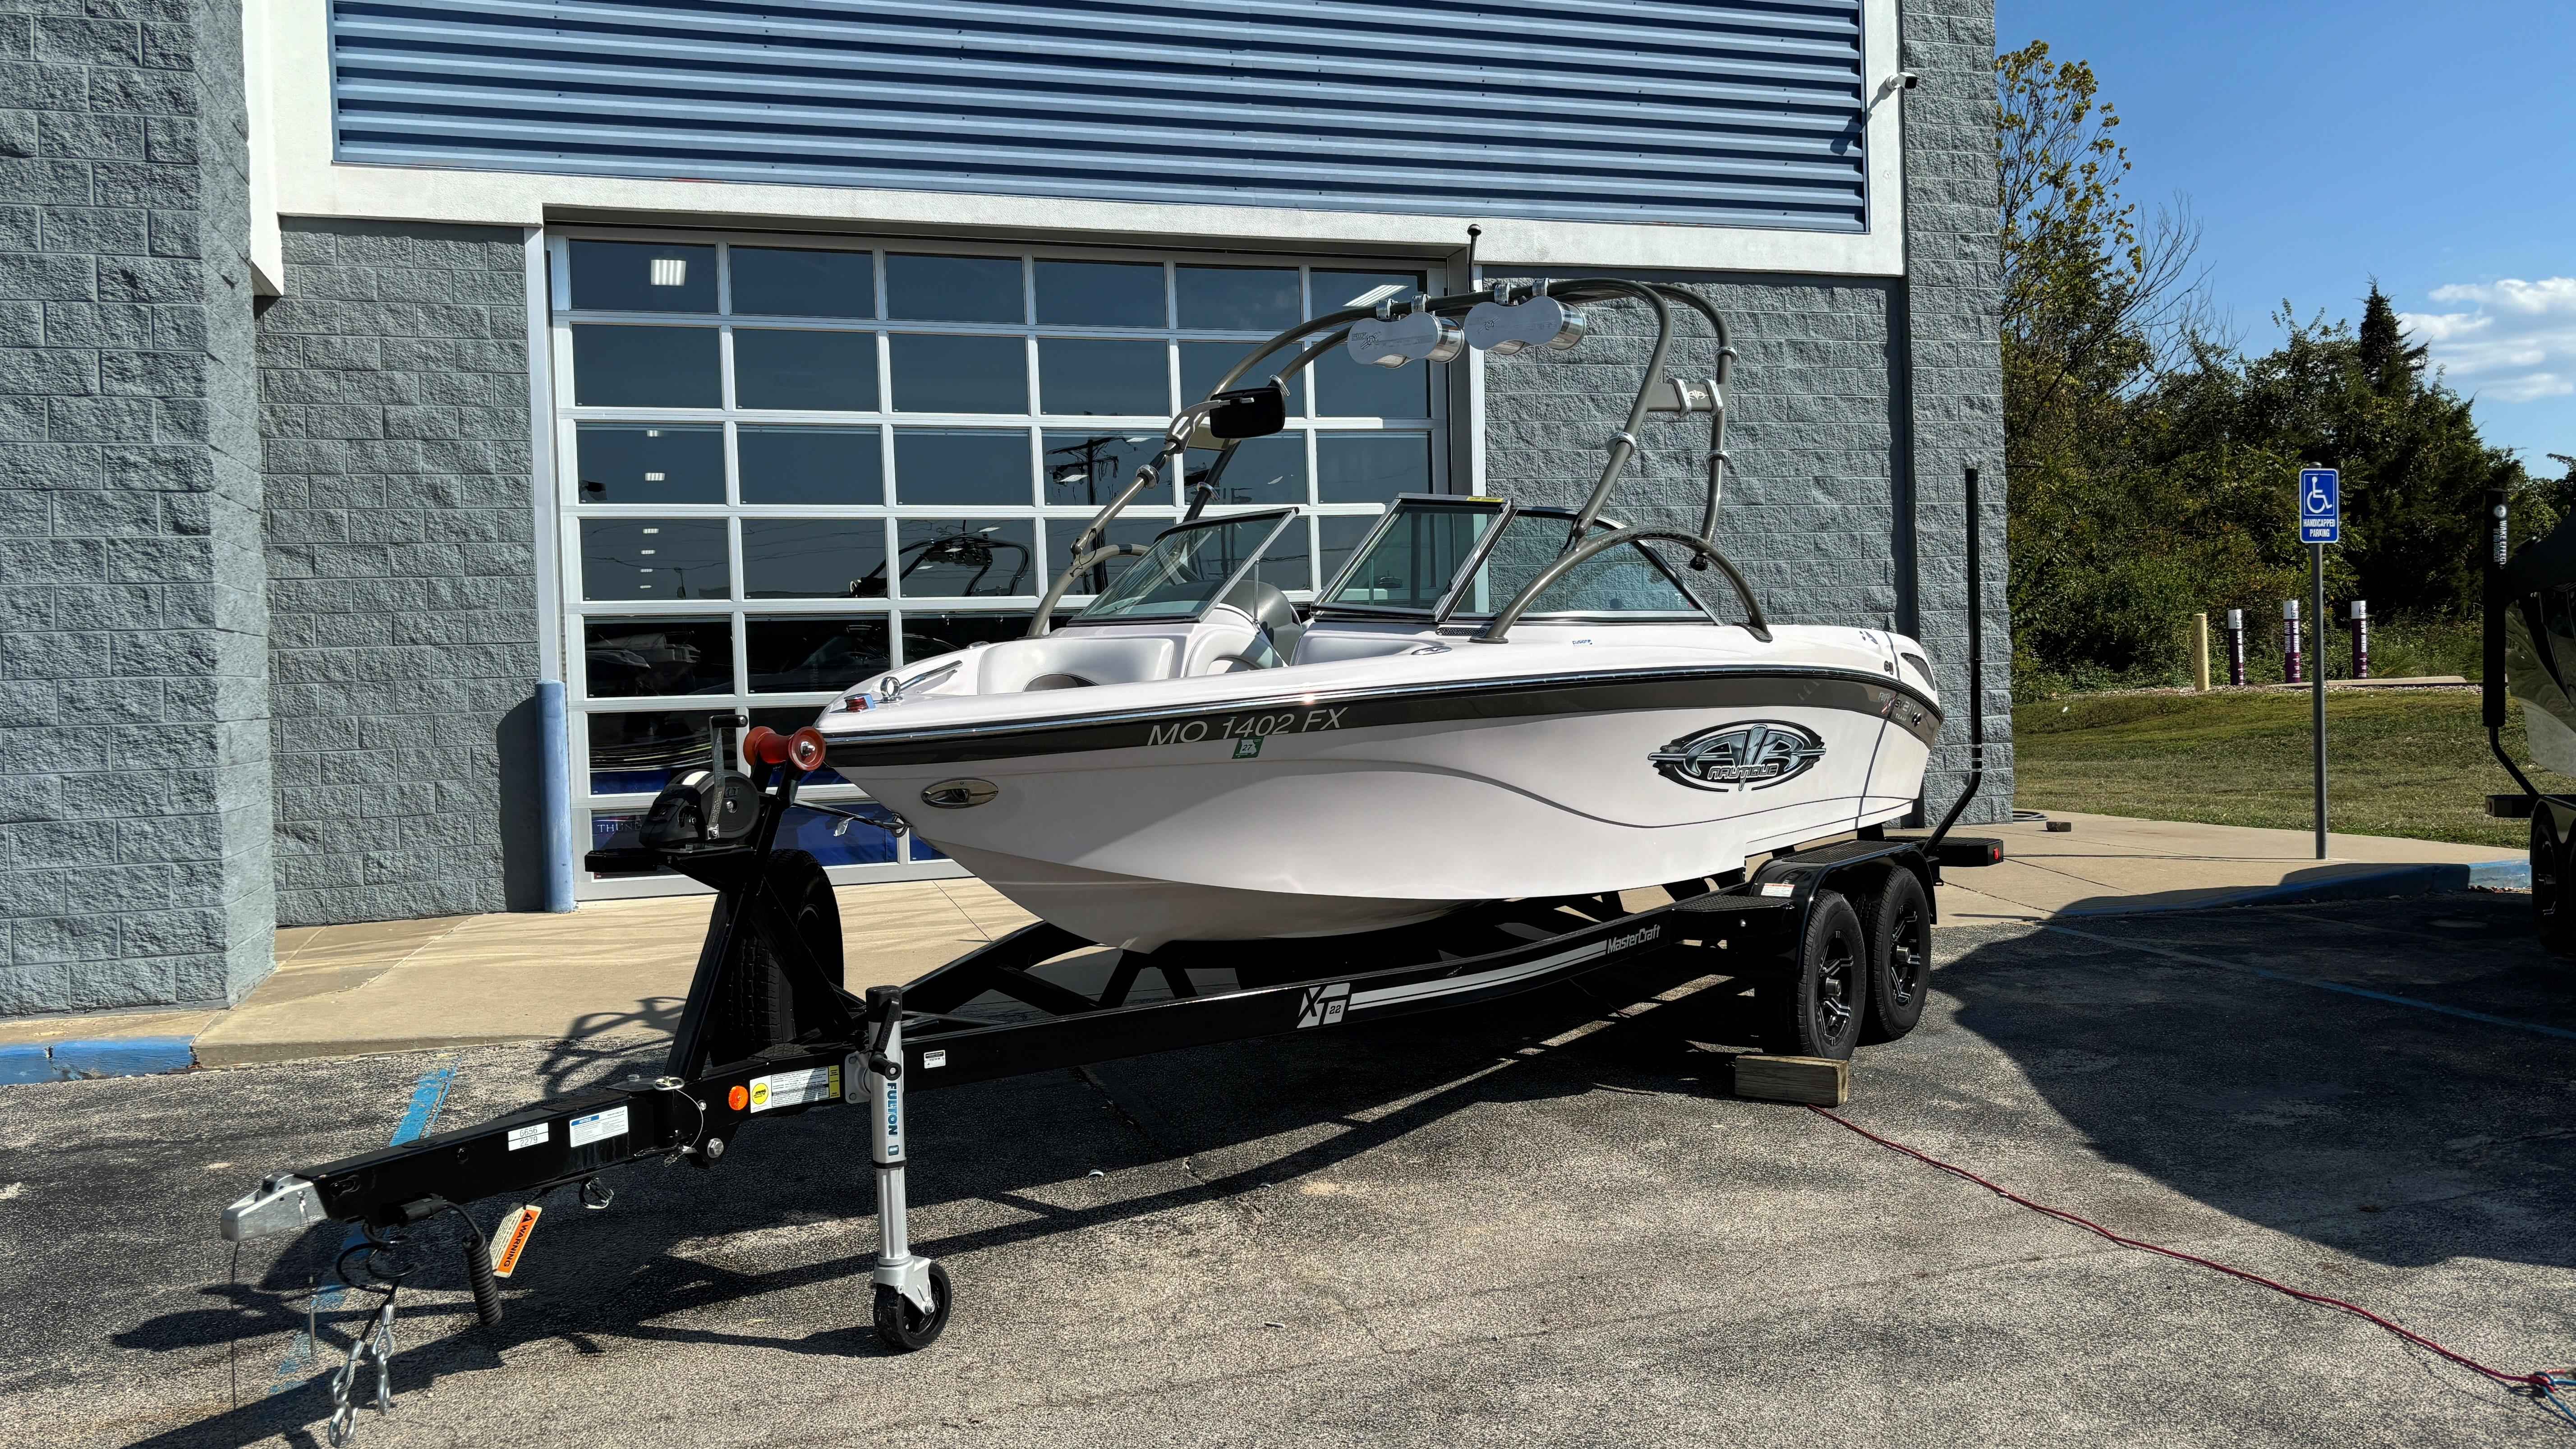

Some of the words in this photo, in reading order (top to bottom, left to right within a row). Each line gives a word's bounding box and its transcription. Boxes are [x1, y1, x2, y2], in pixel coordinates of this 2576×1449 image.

[2303, 519, 2335, 527] HANDICAPPED
[2499, 520, 2507, 540] WAKE
[2309, 529, 2330, 537] PARKING
[1147, 721, 1208, 746] MO
[1222, 715, 1295, 740] 1402
[1301, 707, 1348, 732] FX
[1707, 763, 1779, 782] NAUTIQUE
[1607, 924, 1661, 954] MasterCraft
[1329, 1005, 1342, 1014] 22
[887, 1082, 898, 1136] FULTON
[519, 1126, 538, 1137] 6656
[520, 1136, 538, 1147] 2279
[504, 1224, 529, 1267] WARNING
